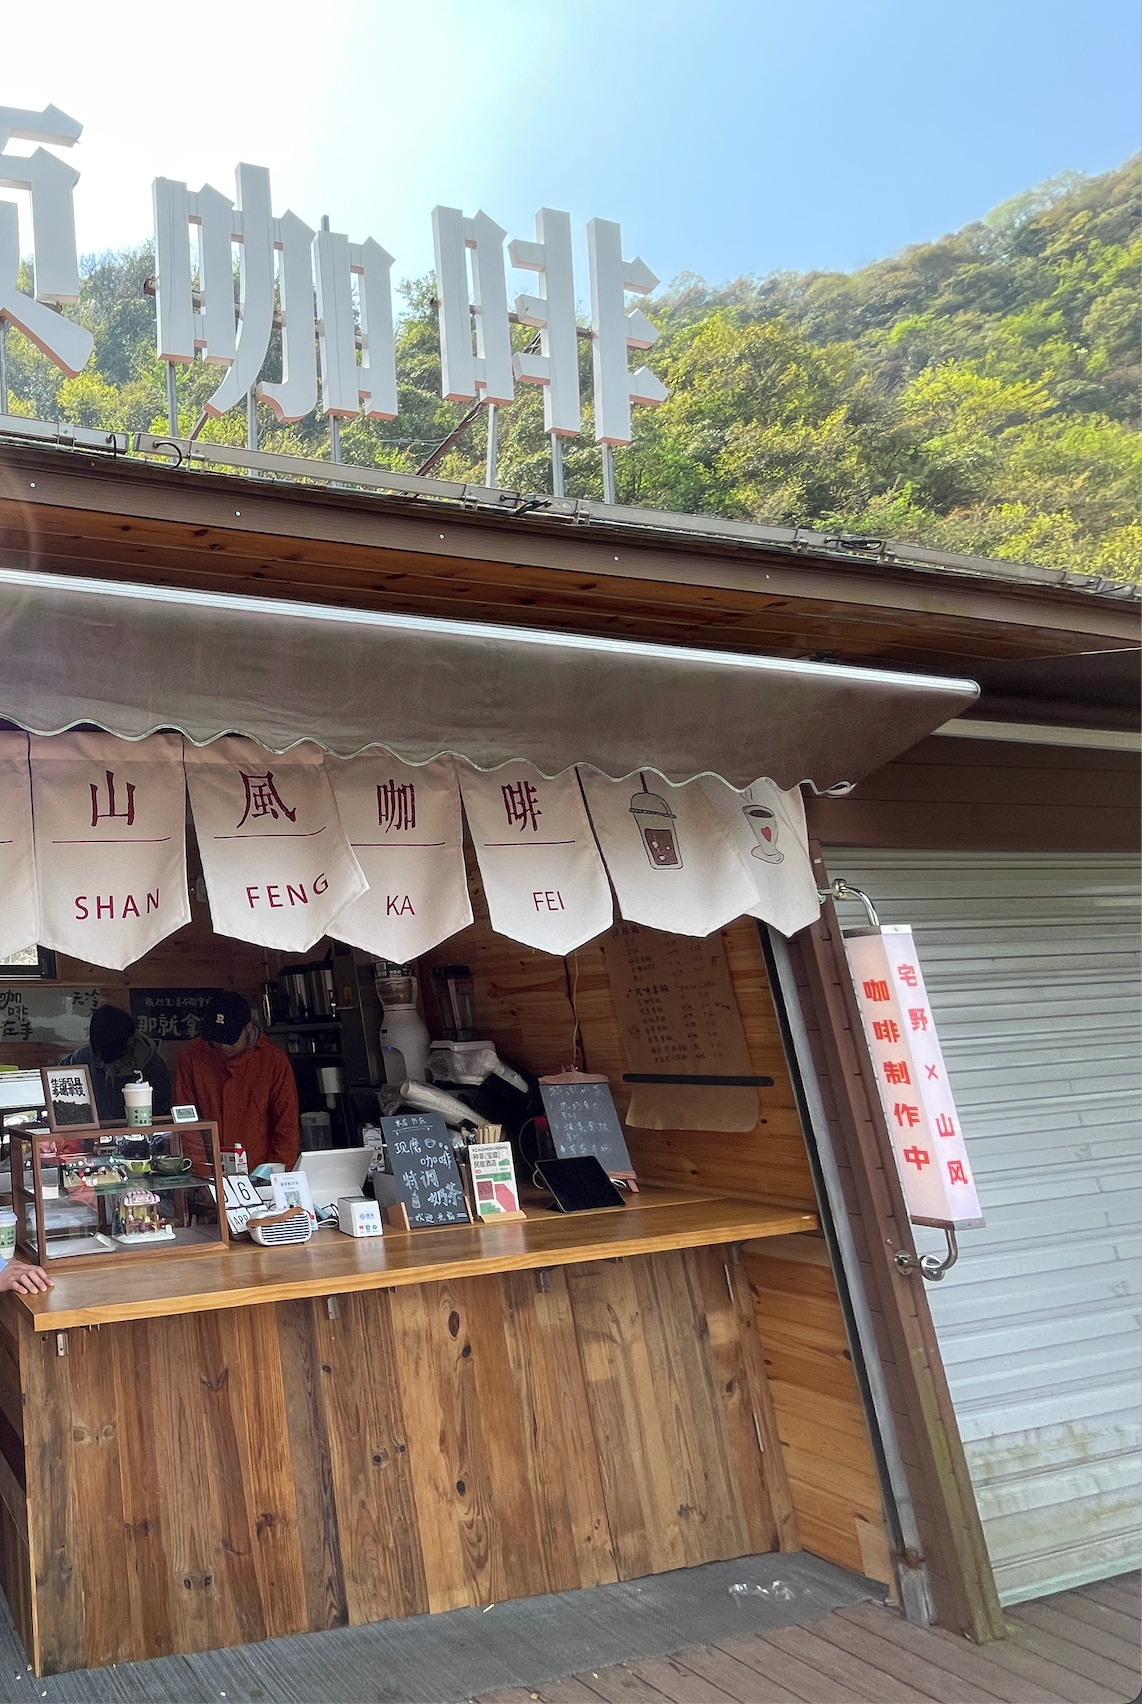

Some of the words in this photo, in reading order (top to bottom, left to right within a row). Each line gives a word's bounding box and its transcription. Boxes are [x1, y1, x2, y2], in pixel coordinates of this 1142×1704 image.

[89, 770, 136, 827] 山
[236, 770, 297, 829] 風
[377, 779, 416, 833] 咖
[502, 780, 540, 832] 啡
[75, 888, 160, 920] SHAN
[246, 872, 330, 909] FENG
[385, 895, 416, 916] KA
[532, 891, 566, 912] FEI
[135, 1012, 206, 1039] 那就拿
[215, 1013, 225, 1025] R
[862, 979, 931, 1171] 咖啡制作中
[420, 1151, 453, 1170] 咖啡
[237, 1181, 251, 1201] 6
[402, 1168, 440, 1191] 特调
[427, 1181, 464, 1208] 奶茶
